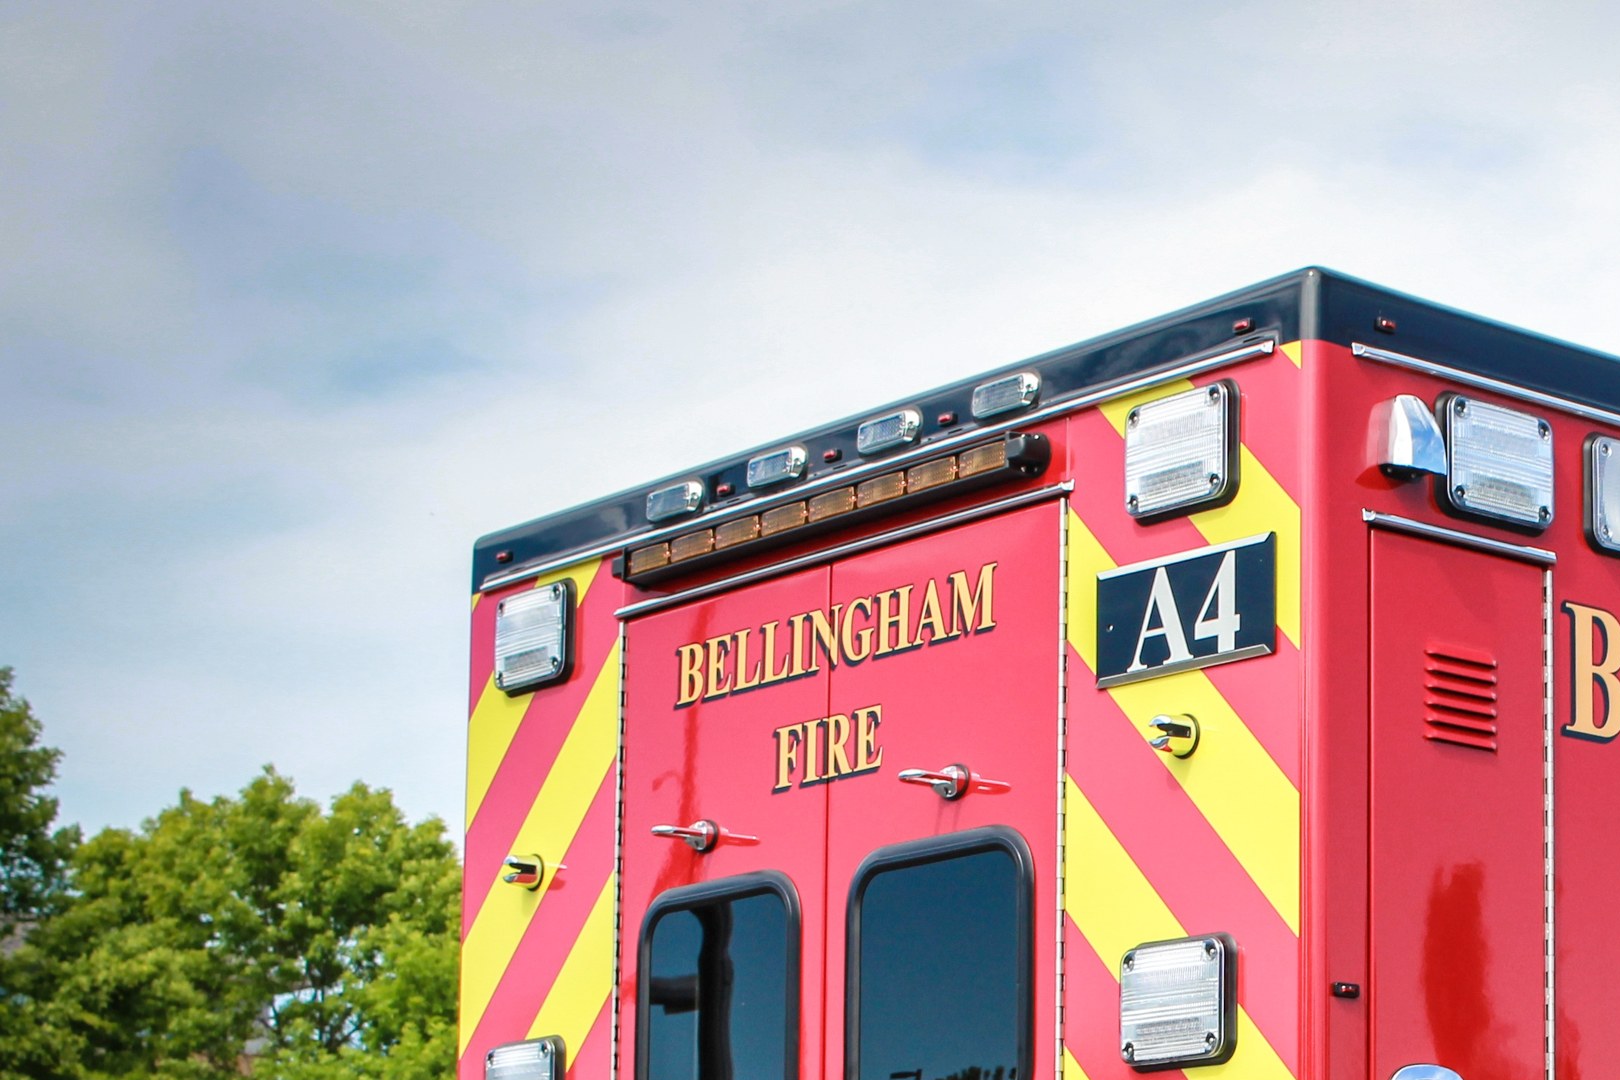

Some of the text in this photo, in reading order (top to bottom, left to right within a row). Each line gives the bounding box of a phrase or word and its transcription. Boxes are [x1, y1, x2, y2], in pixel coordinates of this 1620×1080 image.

[674, 561, 998, 709] BELLINGHAM
[1126, 550, 1241, 673] A4
[772, 703, 883, 794] FIRE
